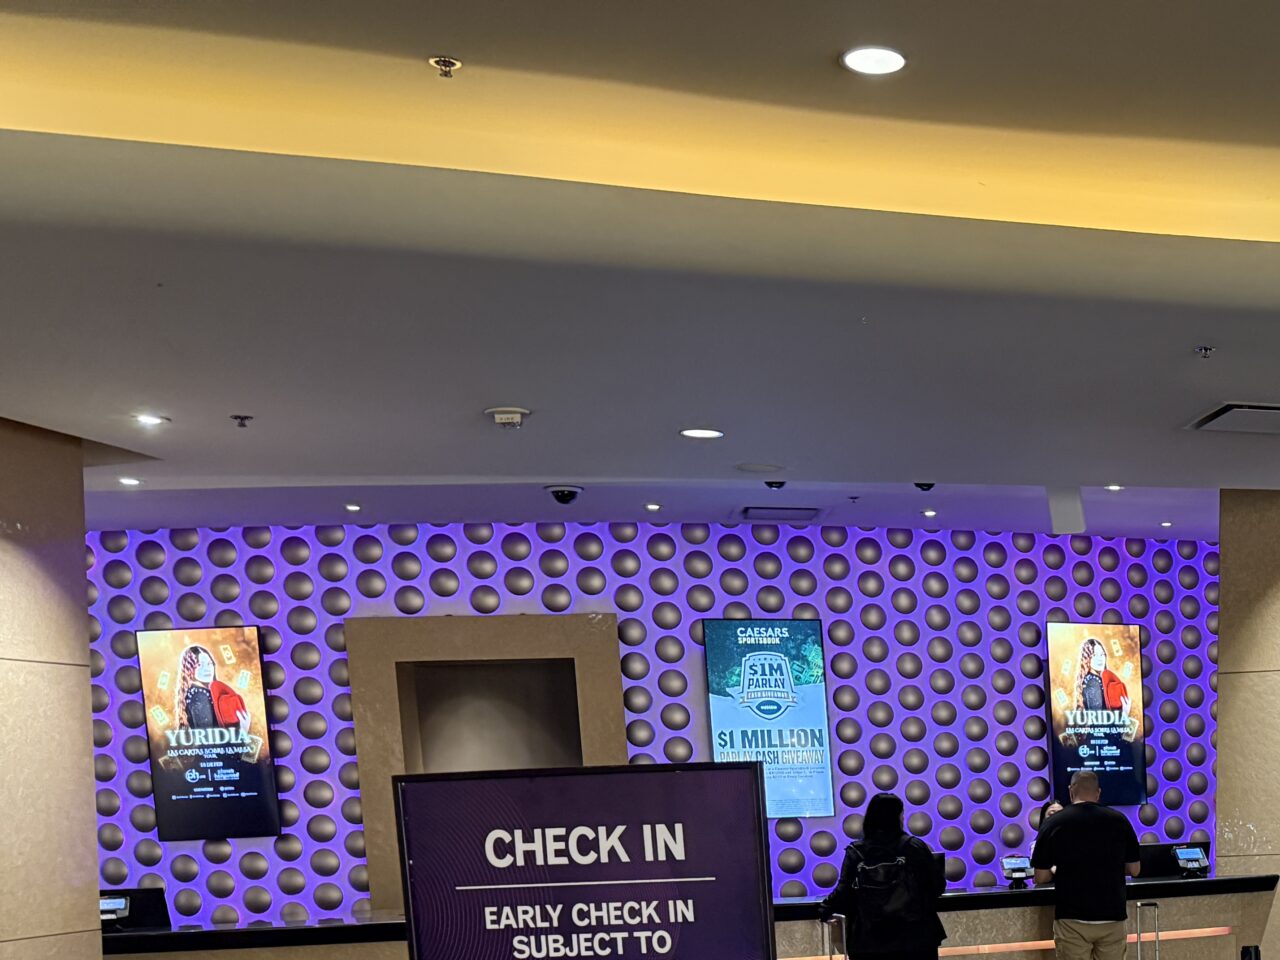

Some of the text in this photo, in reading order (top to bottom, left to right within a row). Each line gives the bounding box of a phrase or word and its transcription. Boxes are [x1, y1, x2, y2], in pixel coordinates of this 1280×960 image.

[737, 627, 789, 637] CAESARS
[737, 637, 780, 645] SPORTSBOOK
[749, 663, 784, 677] $1M
[748, 678, 785, 689] PARLAY
[1065, 710, 1131, 725] YURIDIA
[165, 727, 251, 747] YURIDIA
[717, 728, 824, 749] $1 MILLION
[755, 750, 780, 765] CASH
[781, 749, 825, 765] GIVEAWAY
[485, 823, 686, 868] CHECK IN
[484, 899, 695, 930] EARLY CHECK IN
[512, 930, 672, 959] SUBJECT TO
